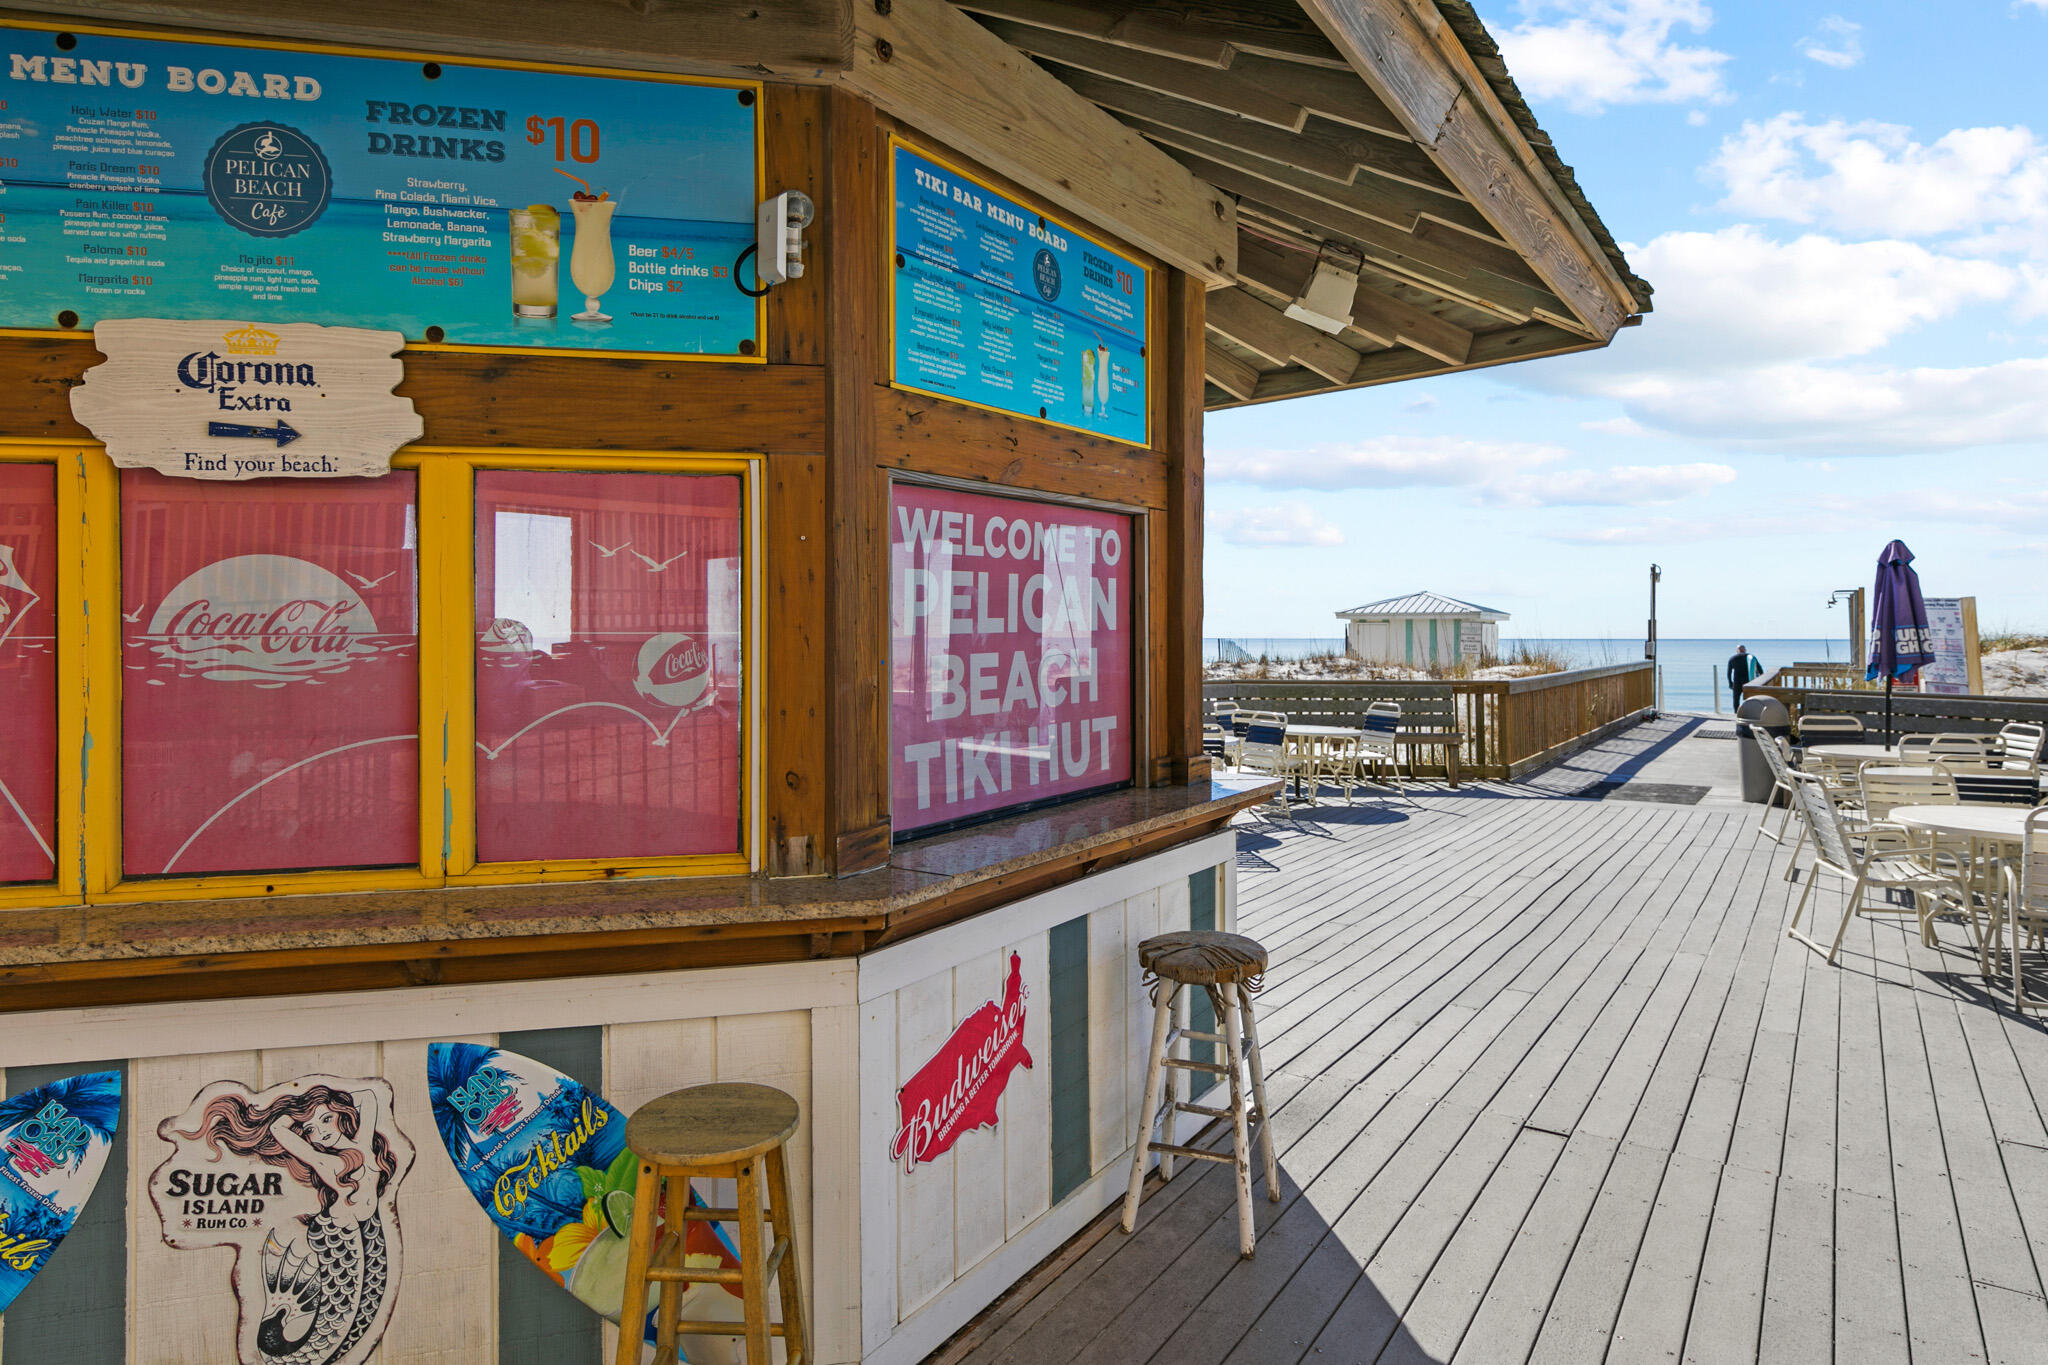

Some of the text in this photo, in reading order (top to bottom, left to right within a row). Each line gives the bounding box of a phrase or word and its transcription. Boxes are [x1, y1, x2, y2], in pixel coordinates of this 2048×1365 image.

[9, 54, 321, 101] MENU BOARD
[72, 105, 156, 120] Holy Water $10
[366, 100, 507, 131] FROZEN
[368, 131, 505, 163] DRINKS
[526, 114, 599, 163] $10
[69, 160, 159, 175] Paris Dream $10
[226, 160, 311, 179] PELICAN
[236, 179, 302, 197] BEACH
[407, 178, 467, 192] Strawberry,
[76, 199, 153, 212] Pain Killer $10
[376, 189, 498, 207] Pina Colada, Miami Vice,
[914, 168, 948, 197] TIKI
[953, 186, 982, 213] BAR
[987, 203, 1024, 231] MENU
[1029, 223, 1067, 252] BOARD
[385, 204, 489, 220] Mango, Bushwacker,
[387, 218, 487, 234] Lemonade, Banana,
[83, 244, 147, 256] Paloma $10
[383, 232, 491, 248] Strawberry Margarita
[629, 244, 694, 259] Beer $4/5
[239, 255, 294, 266] Mojito $11
[409, 264, 421, 272] be
[424, 265, 448, 274] made
[451, 266, 484, 275] without
[423, 253, 487, 263] Frozen drinks
[629, 261, 728, 278] Bottle drinks $3
[1083, 251, 1113, 274] FROZEN
[79, 274, 152, 285] Margarita $10
[412, 276, 445, 285] Alcohol
[629, 279, 683, 293] Chips $2
[1084, 266, 1113, 288] DRINKS
[1116, 269, 1132, 295] $10
[177, 351, 317, 393] Corona
[218, 387, 292, 412] Extra
[184, 453, 227, 472] Find
[235, 456, 275, 478] your
[897, 506, 1121, 566] WELCOME TO
[904, 568, 1117, 636] PELICAN
[166, 600, 361, 655] Coca-Cola
[931, 648, 1098, 721] BEACH
[905, 716, 1117, 810] TIKI HUT
[447, 1066, 497, 1113] ISLAND
[889, 993, 1025, 1174] Budweiser
[463, 1078, 514, 1125] OASIS
[938, 1104, 965, 1142] BREWING
[964, 1096, 970, 1107] A
[969, 1069, 989, 1100] BETTER
[36, 1099, 91, 1146] ISLAND
[20, 1119, 75, 1166] OASIS
[470, 1160, 484, 1172] The
[482, 1138, 508, 1162] World's
[506, 1120, 526, 1142] Finest
[524, 1104, 547, 1123] Frozen
[494, 1097, 609, 1217] Cocktails
[0, 1166, 20, 1186] Finest
[20, 1179, 43, 1201] Frozen
[166, 1169, 283, 1196] SUGAR
[183, 1199, 265, 1215] ISLAND
[196, 1217, 248, 1229] RUM CO.
